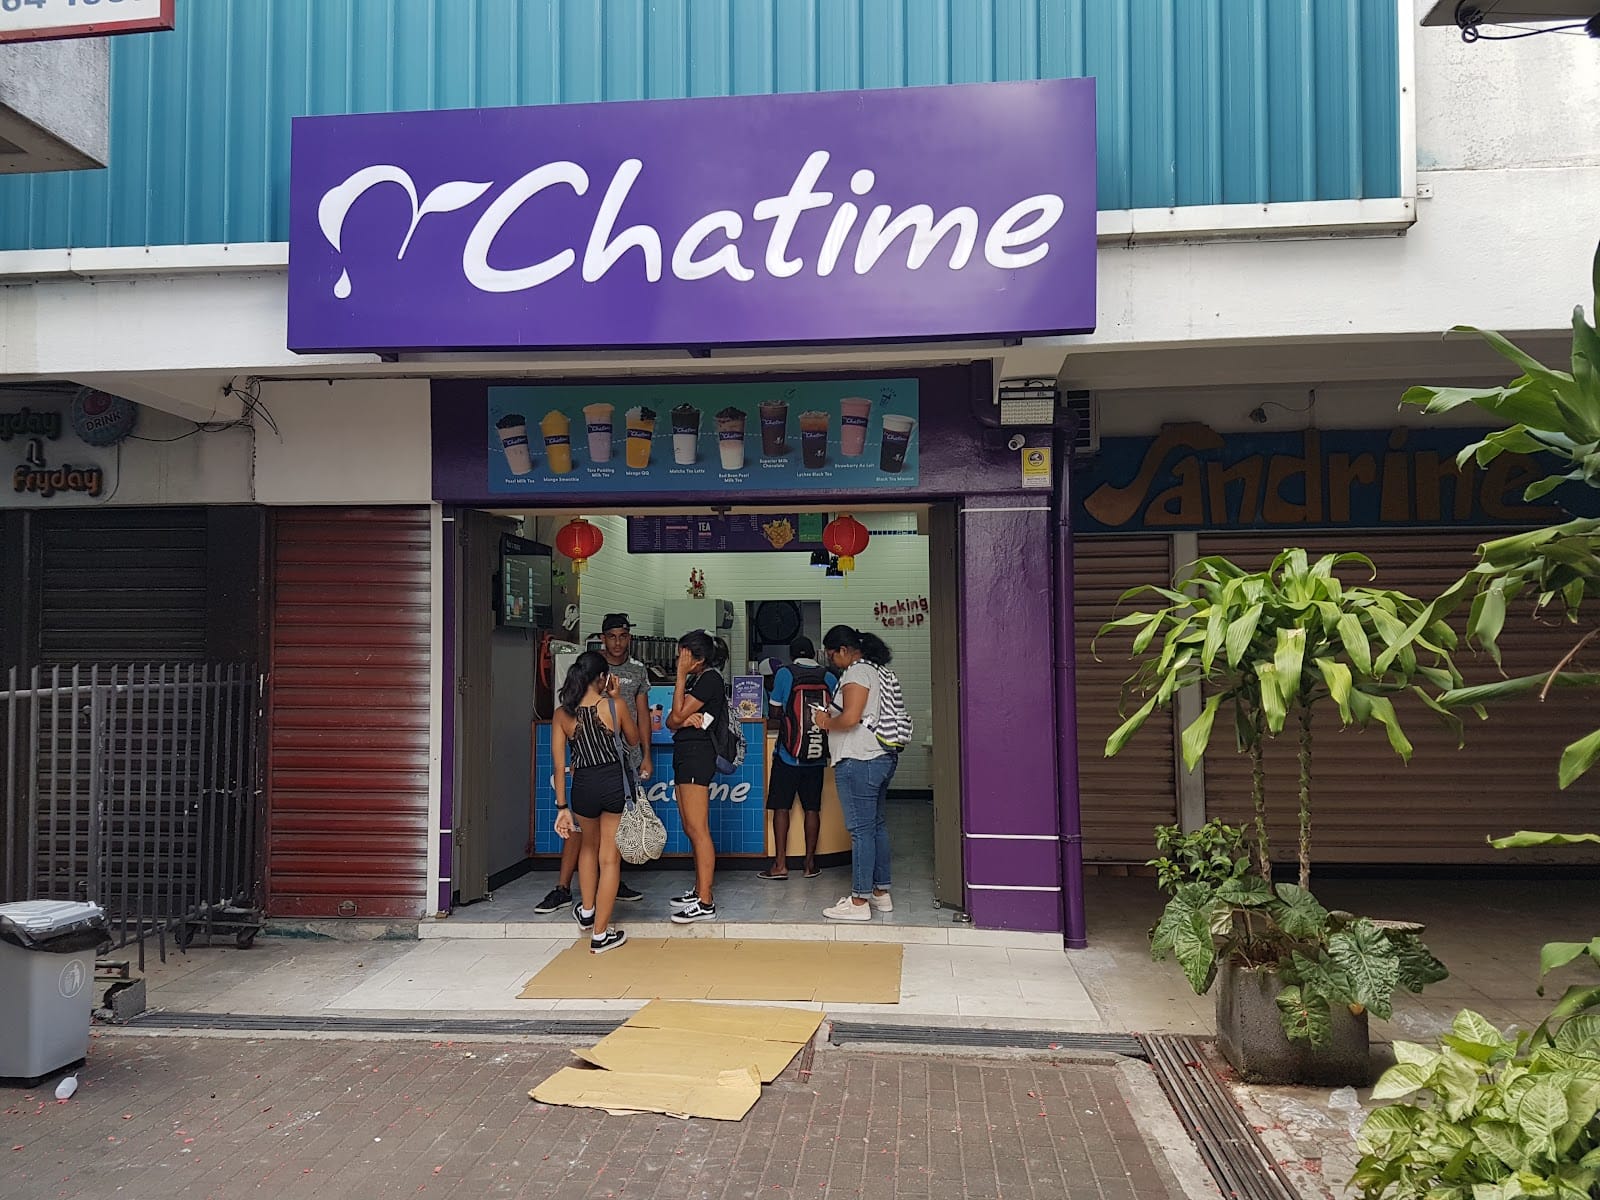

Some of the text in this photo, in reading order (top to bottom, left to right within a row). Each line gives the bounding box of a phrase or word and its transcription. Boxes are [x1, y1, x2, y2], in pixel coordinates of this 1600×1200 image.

[463, 151, 1064, 293] Chatime
[1083, 422, 1564, 527] Sandrine
[698, 522, 711, 532] TEA
[874, 597, 929, 615] shaking
[881, 613, 924, 627] tea up
[806, 702, 824, 760] Wils
